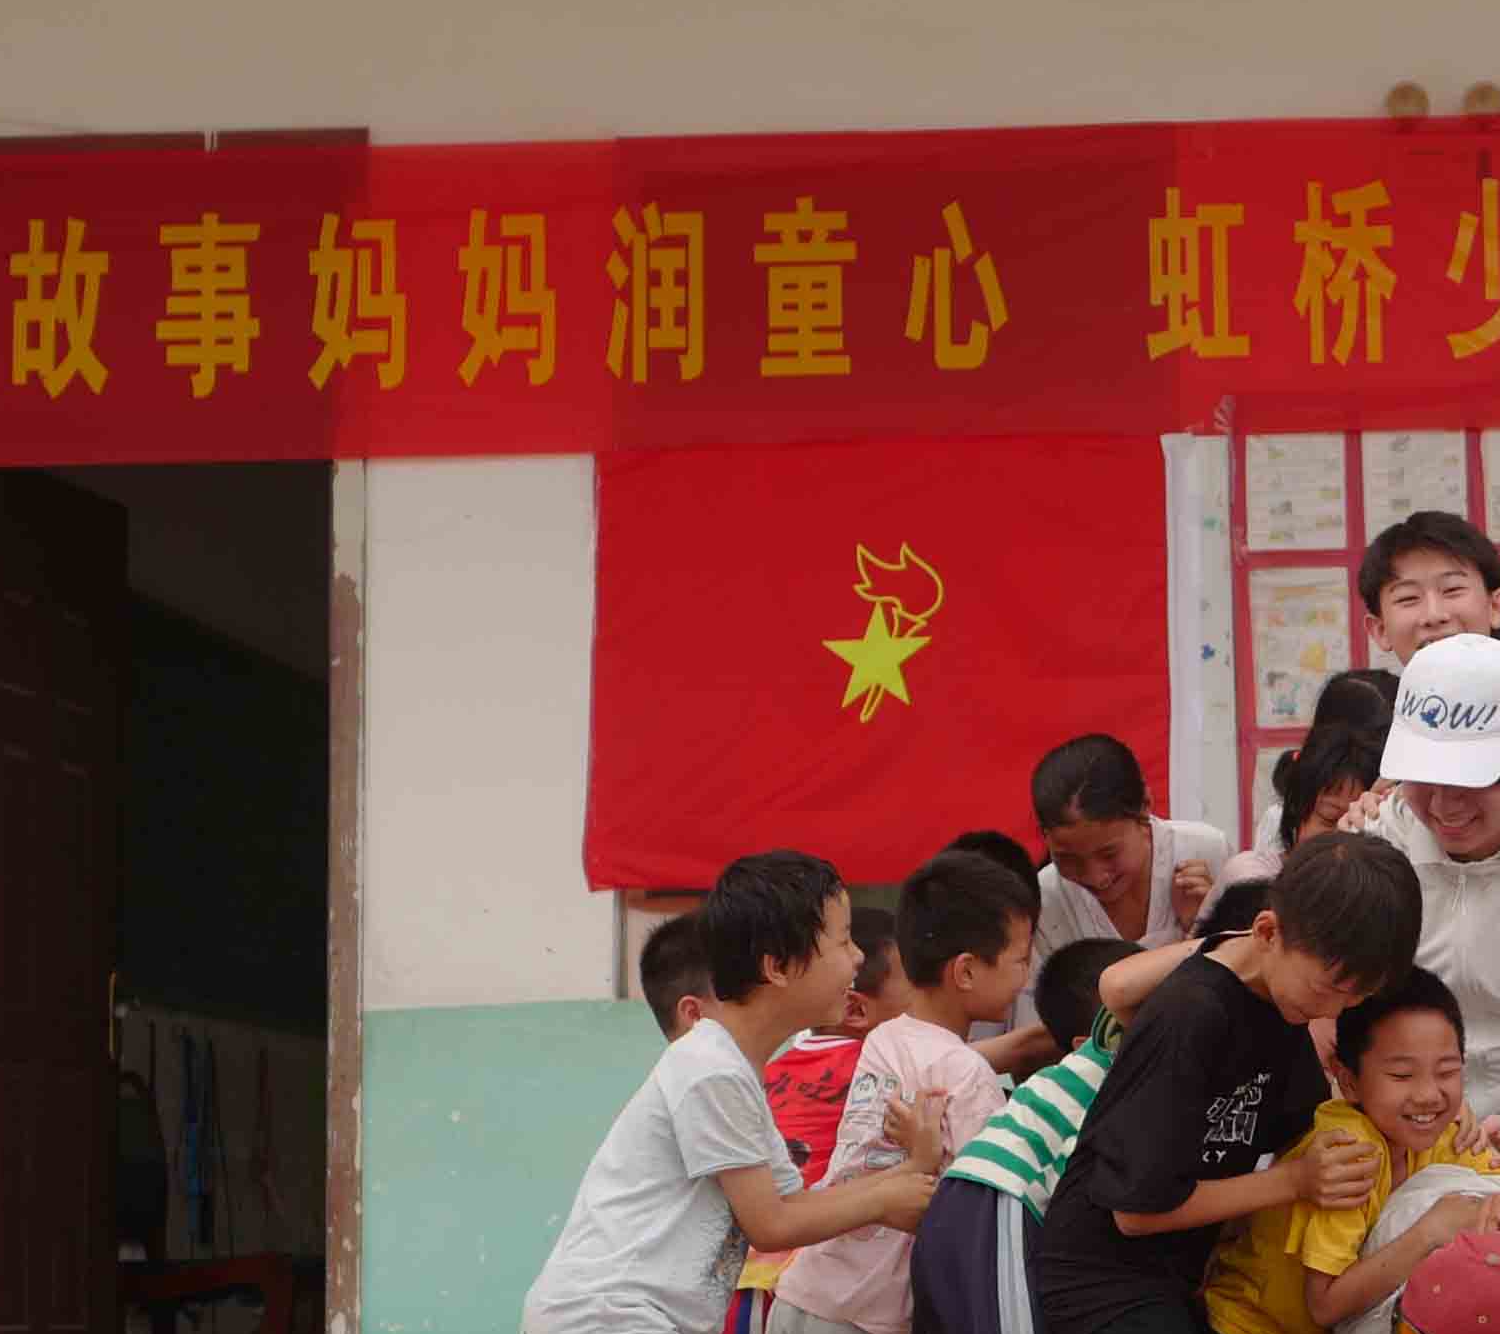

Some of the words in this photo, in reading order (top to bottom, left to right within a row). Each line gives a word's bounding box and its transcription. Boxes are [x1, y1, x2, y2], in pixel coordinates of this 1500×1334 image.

[9, 198, 1010, 398] 故事妈妈润童心
[1400, 690, 1498, 731] WOW!
